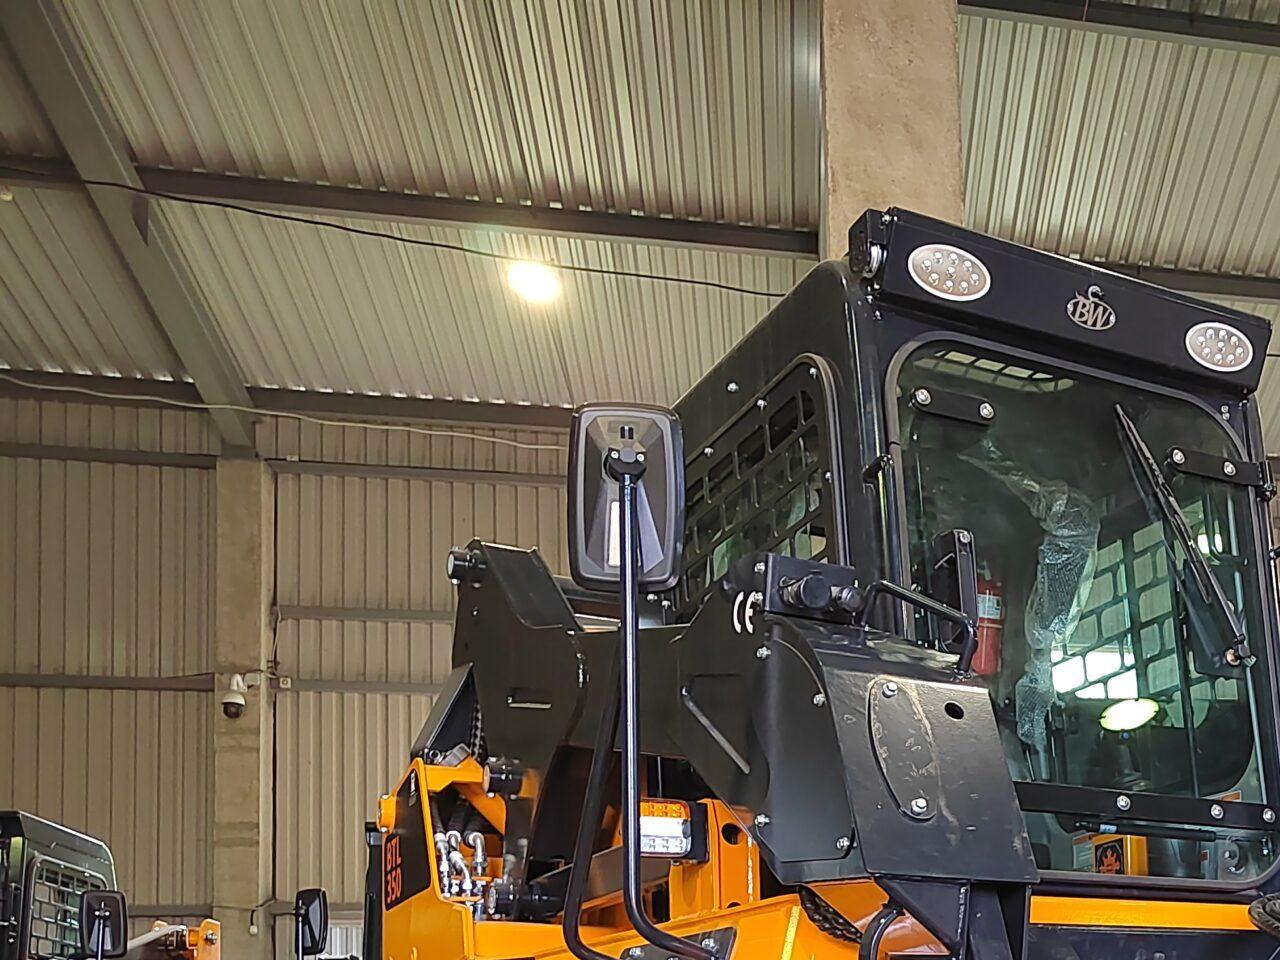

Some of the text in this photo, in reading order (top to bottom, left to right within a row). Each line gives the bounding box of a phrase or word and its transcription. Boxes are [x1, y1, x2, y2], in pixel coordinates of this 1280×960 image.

[1074, 299, 1111, 329] BW
[387, 835, 401, 870] BTL
[387, 868, 402, 903] 350
